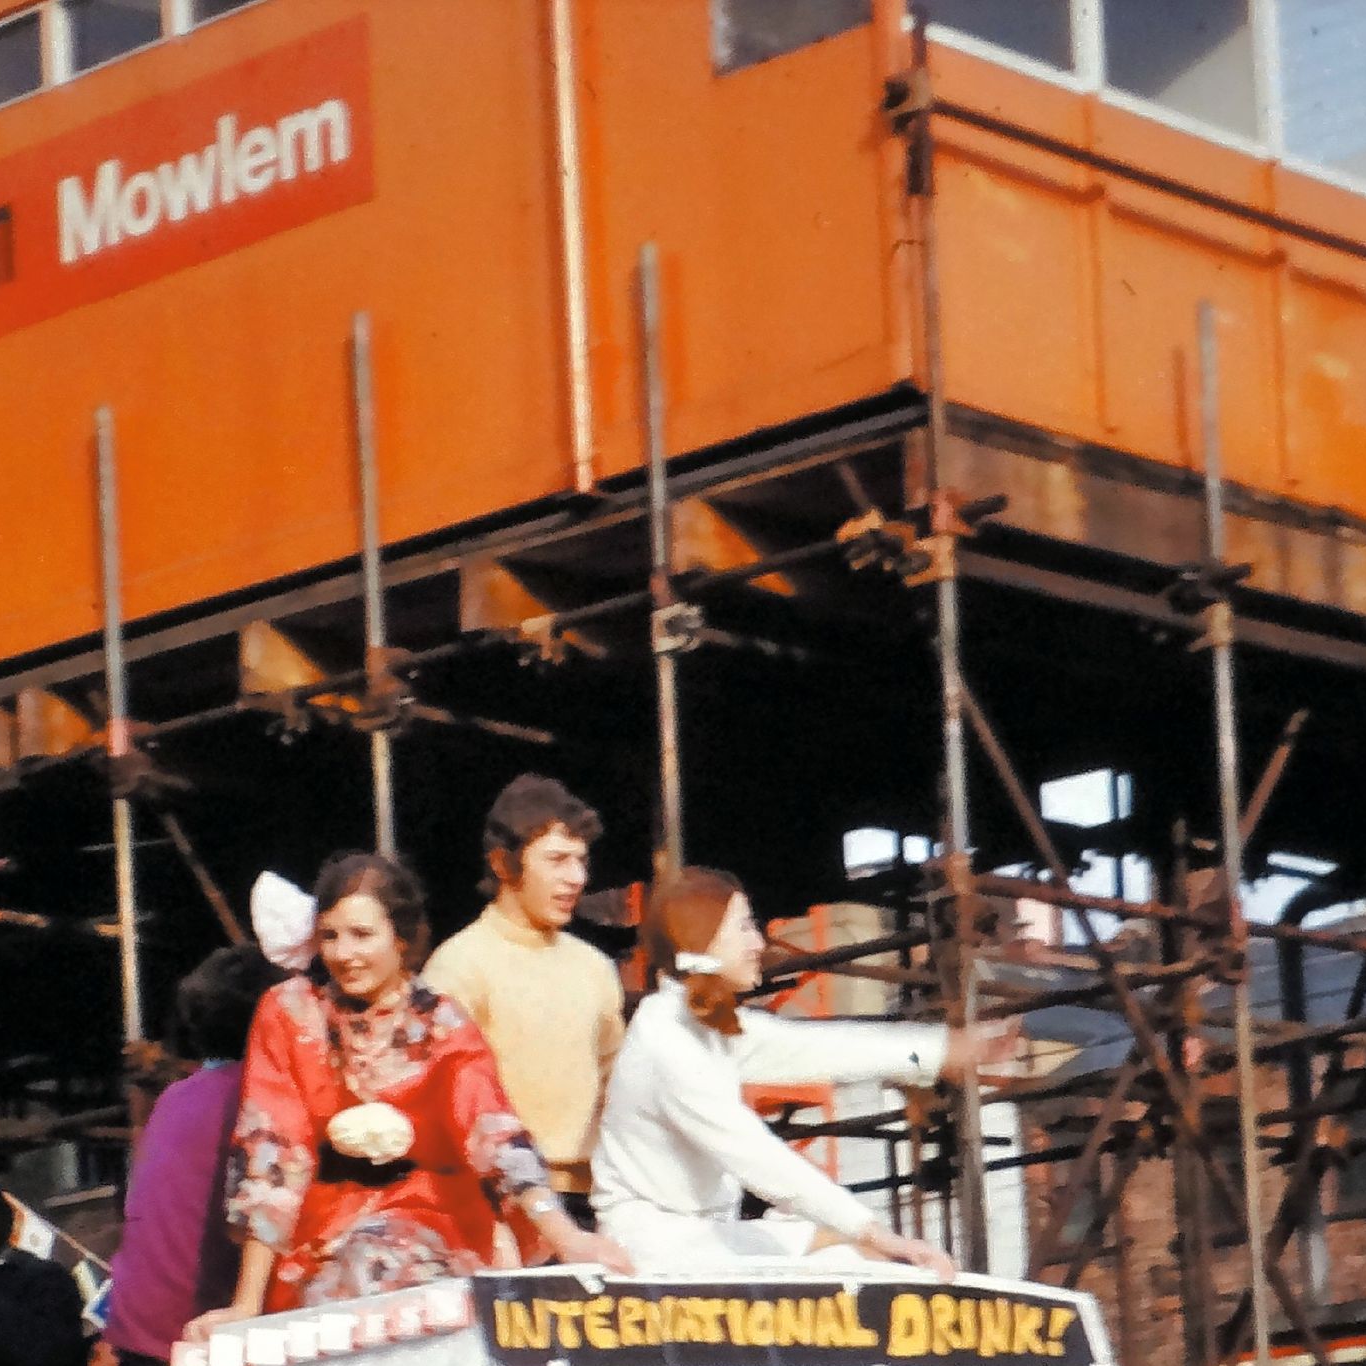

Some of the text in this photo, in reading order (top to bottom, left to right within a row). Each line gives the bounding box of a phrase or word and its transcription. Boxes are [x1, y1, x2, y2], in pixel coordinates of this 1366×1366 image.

[56, 98, 351, 265] Mowlem
[492, 1291, 879, 1350] INTERNATIONAL
[885, 1292, 1077, 1359] DRINK!
